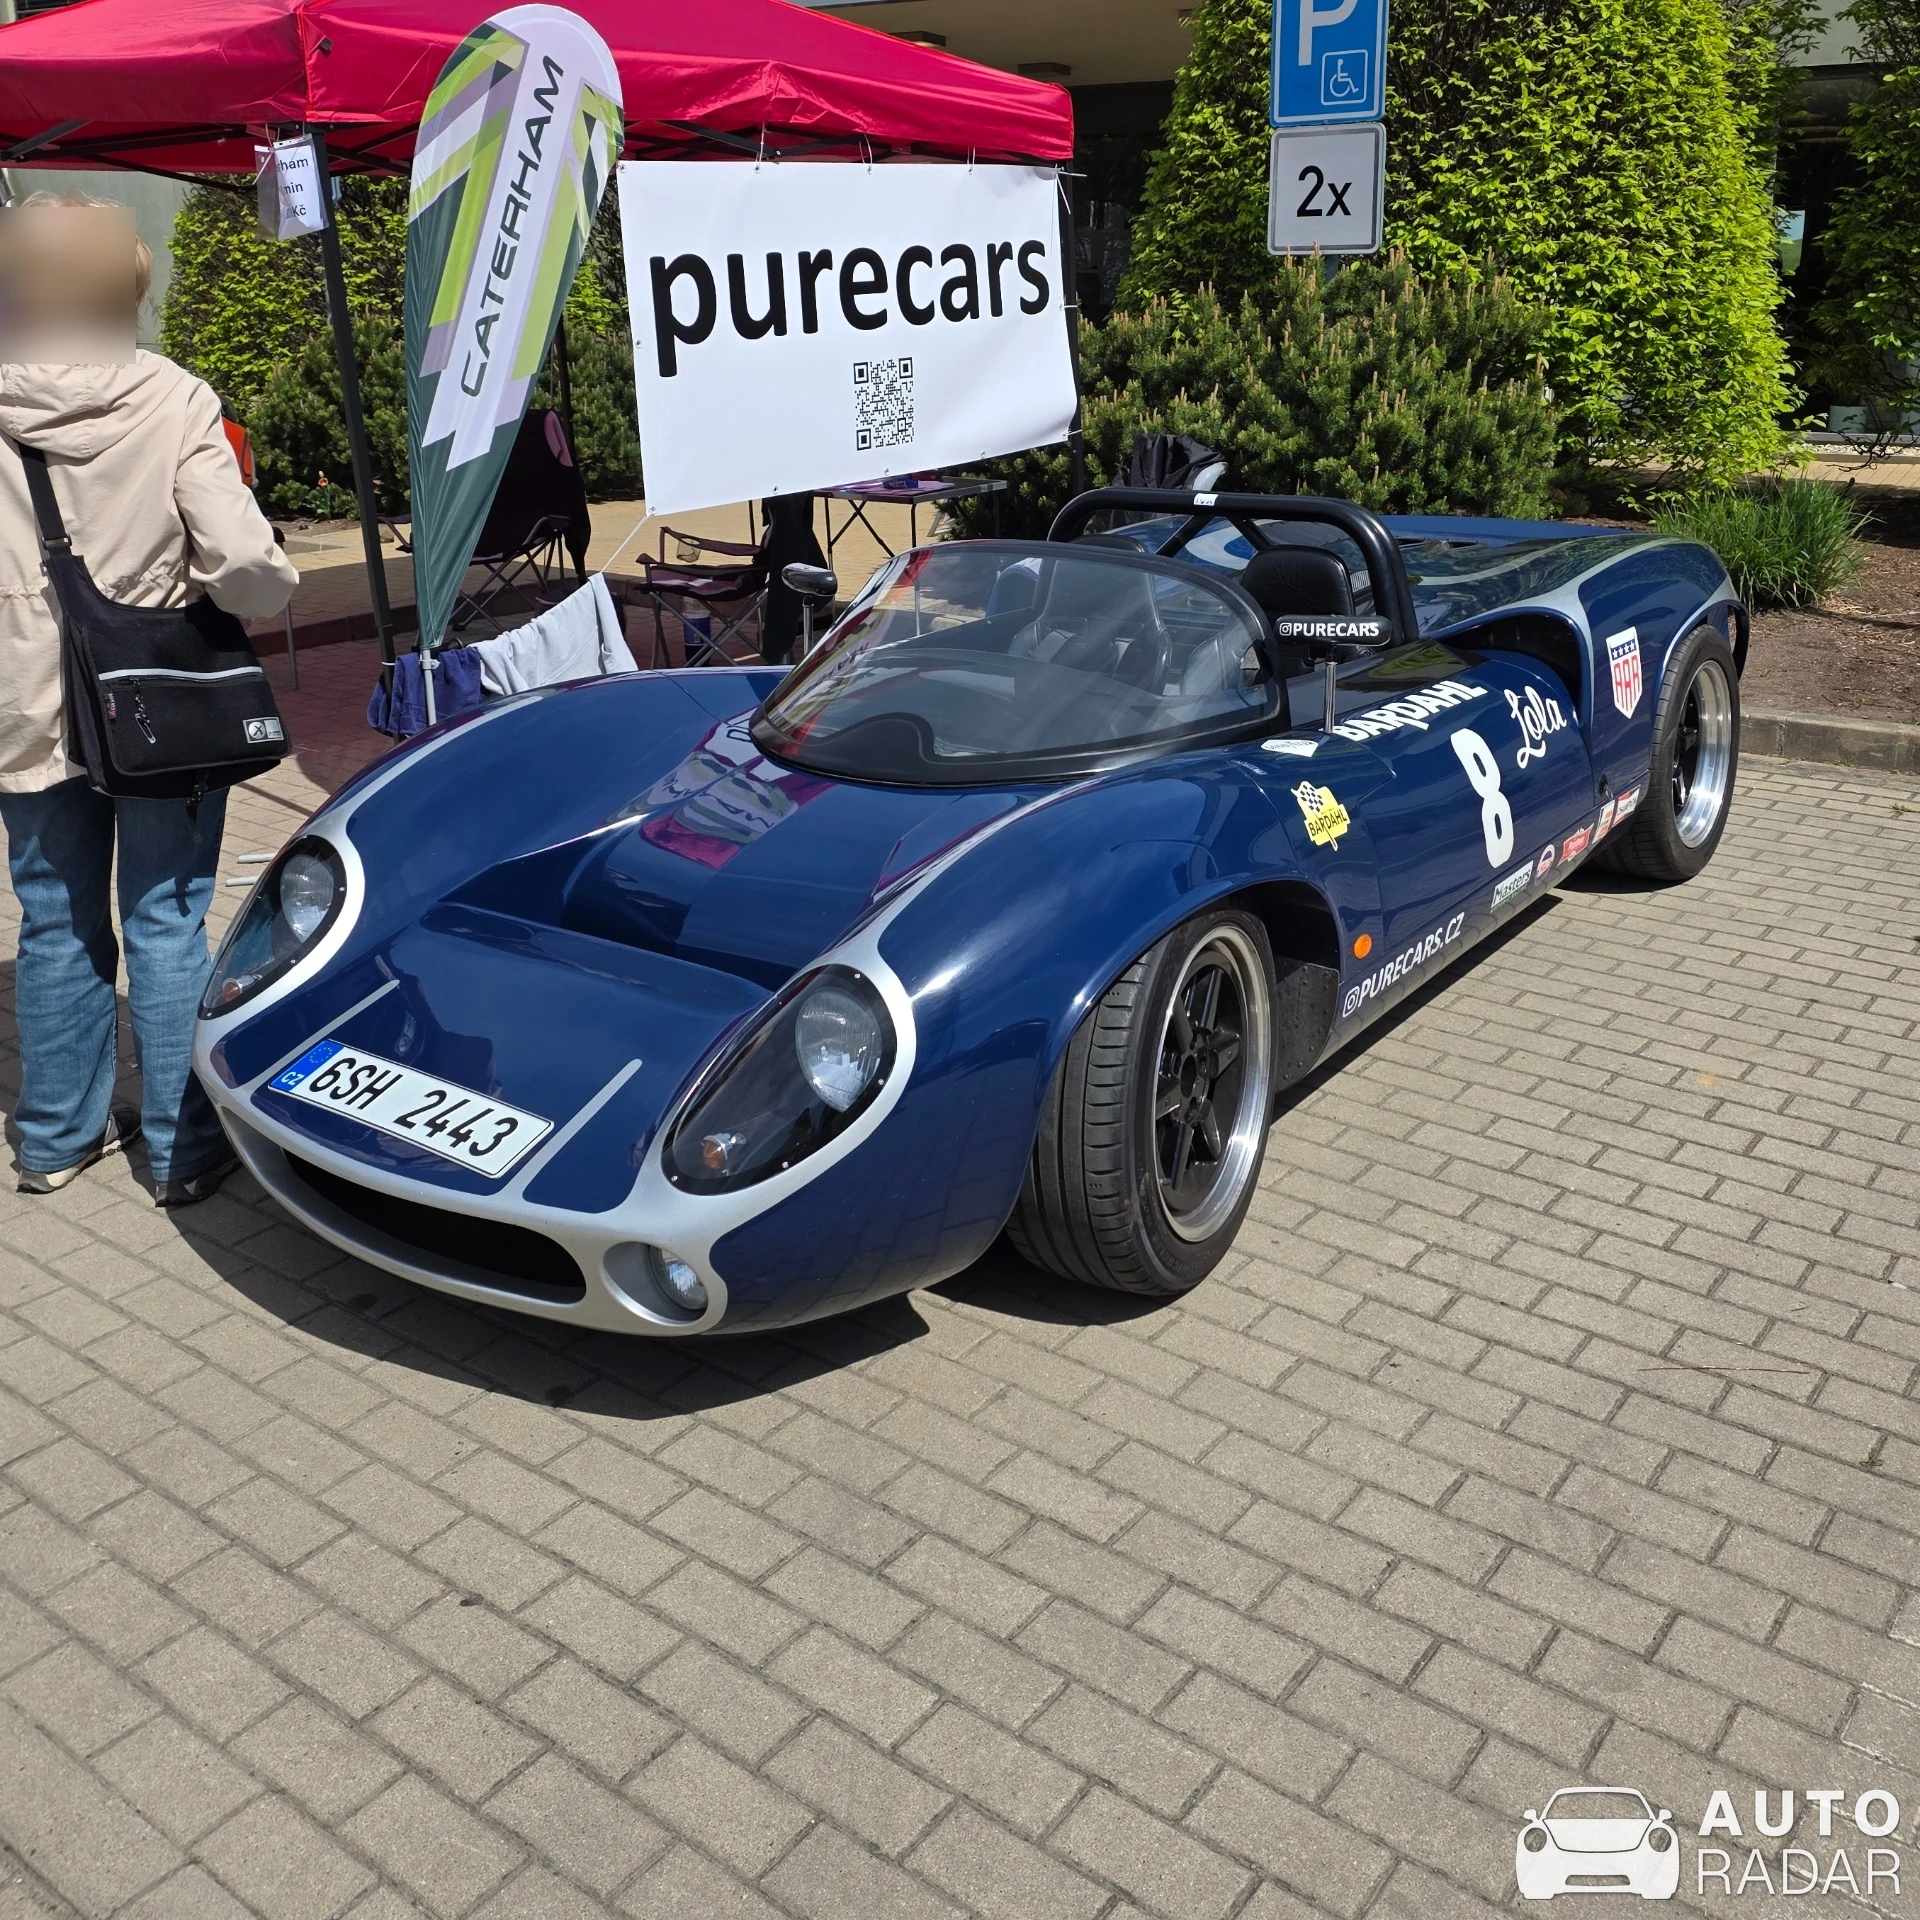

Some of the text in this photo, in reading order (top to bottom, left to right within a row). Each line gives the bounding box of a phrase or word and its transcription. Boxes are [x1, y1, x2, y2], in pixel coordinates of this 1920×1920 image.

[461, 55, 564, 397] CATERHAM
[1297, 165, 1353, 217] 2x
[649, 239, 1050, 378] purecars
[1318, 680, 1488, 742] BARDAHL
[1503, 685, 1567, 769] Lola
[1308, 808, 1348, 837] BARDAHL
[1450, 728, 1515, 868] 8
[1493, 868, 1531, 906] Masters
[281, 1071, 305, 1086] CZ
[309, 1057, 519, 1157] 6SH 2443
